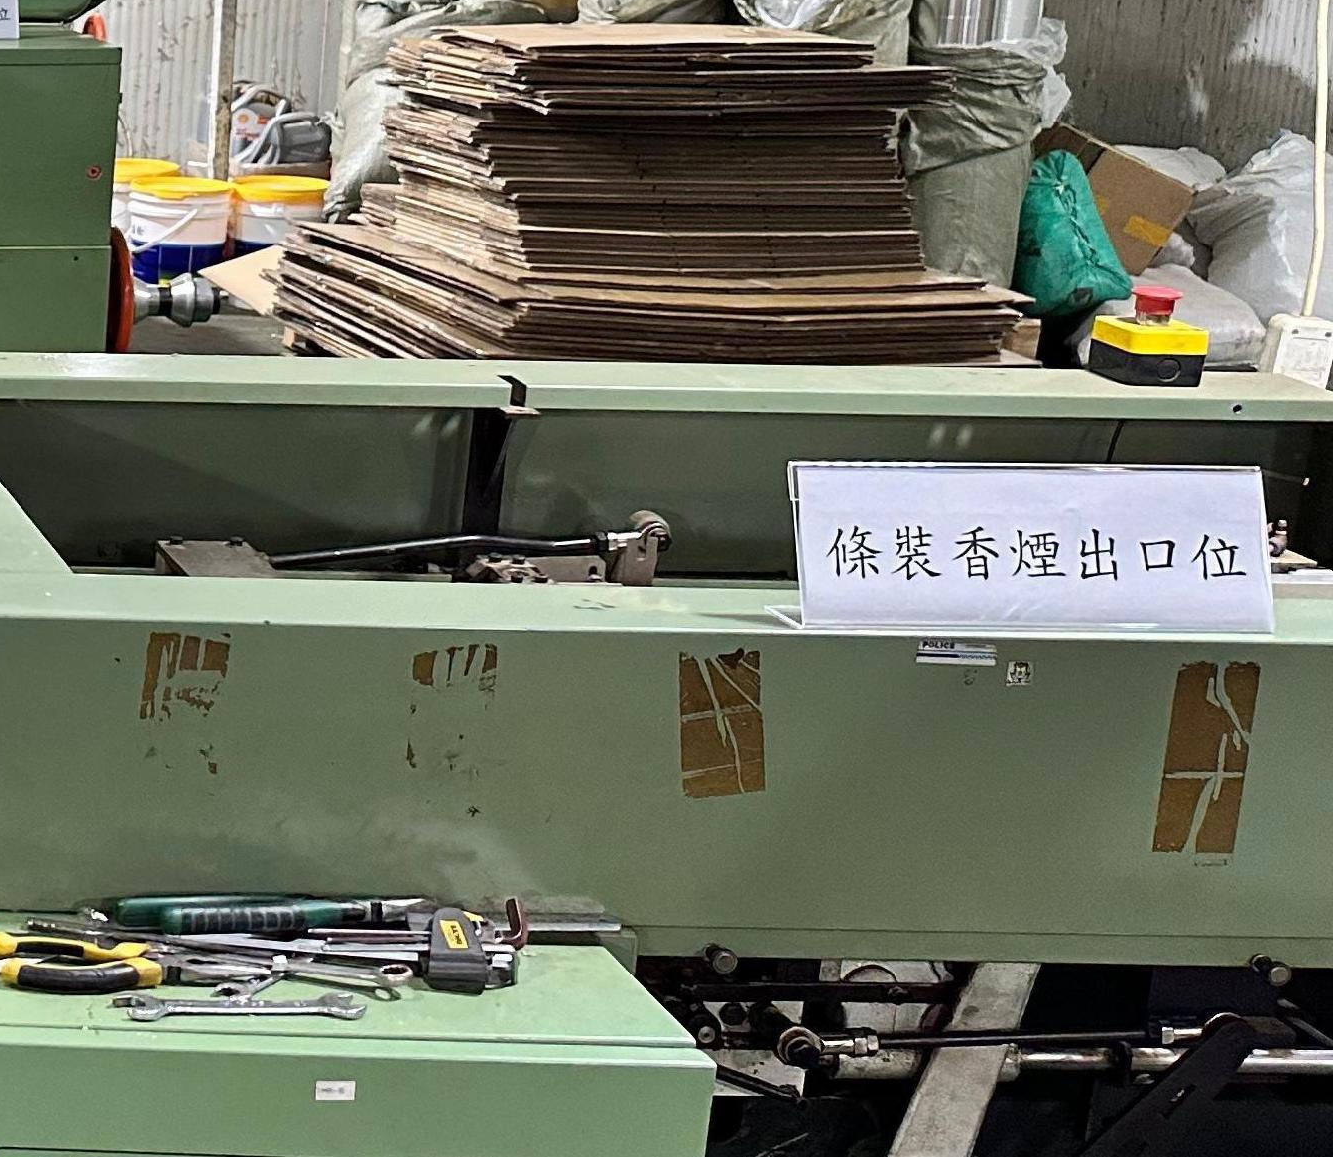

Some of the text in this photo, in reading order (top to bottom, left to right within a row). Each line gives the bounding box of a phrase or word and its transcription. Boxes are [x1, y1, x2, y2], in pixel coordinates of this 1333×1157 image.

[826, 525, 1247, 581] 條裝香煙出口位
